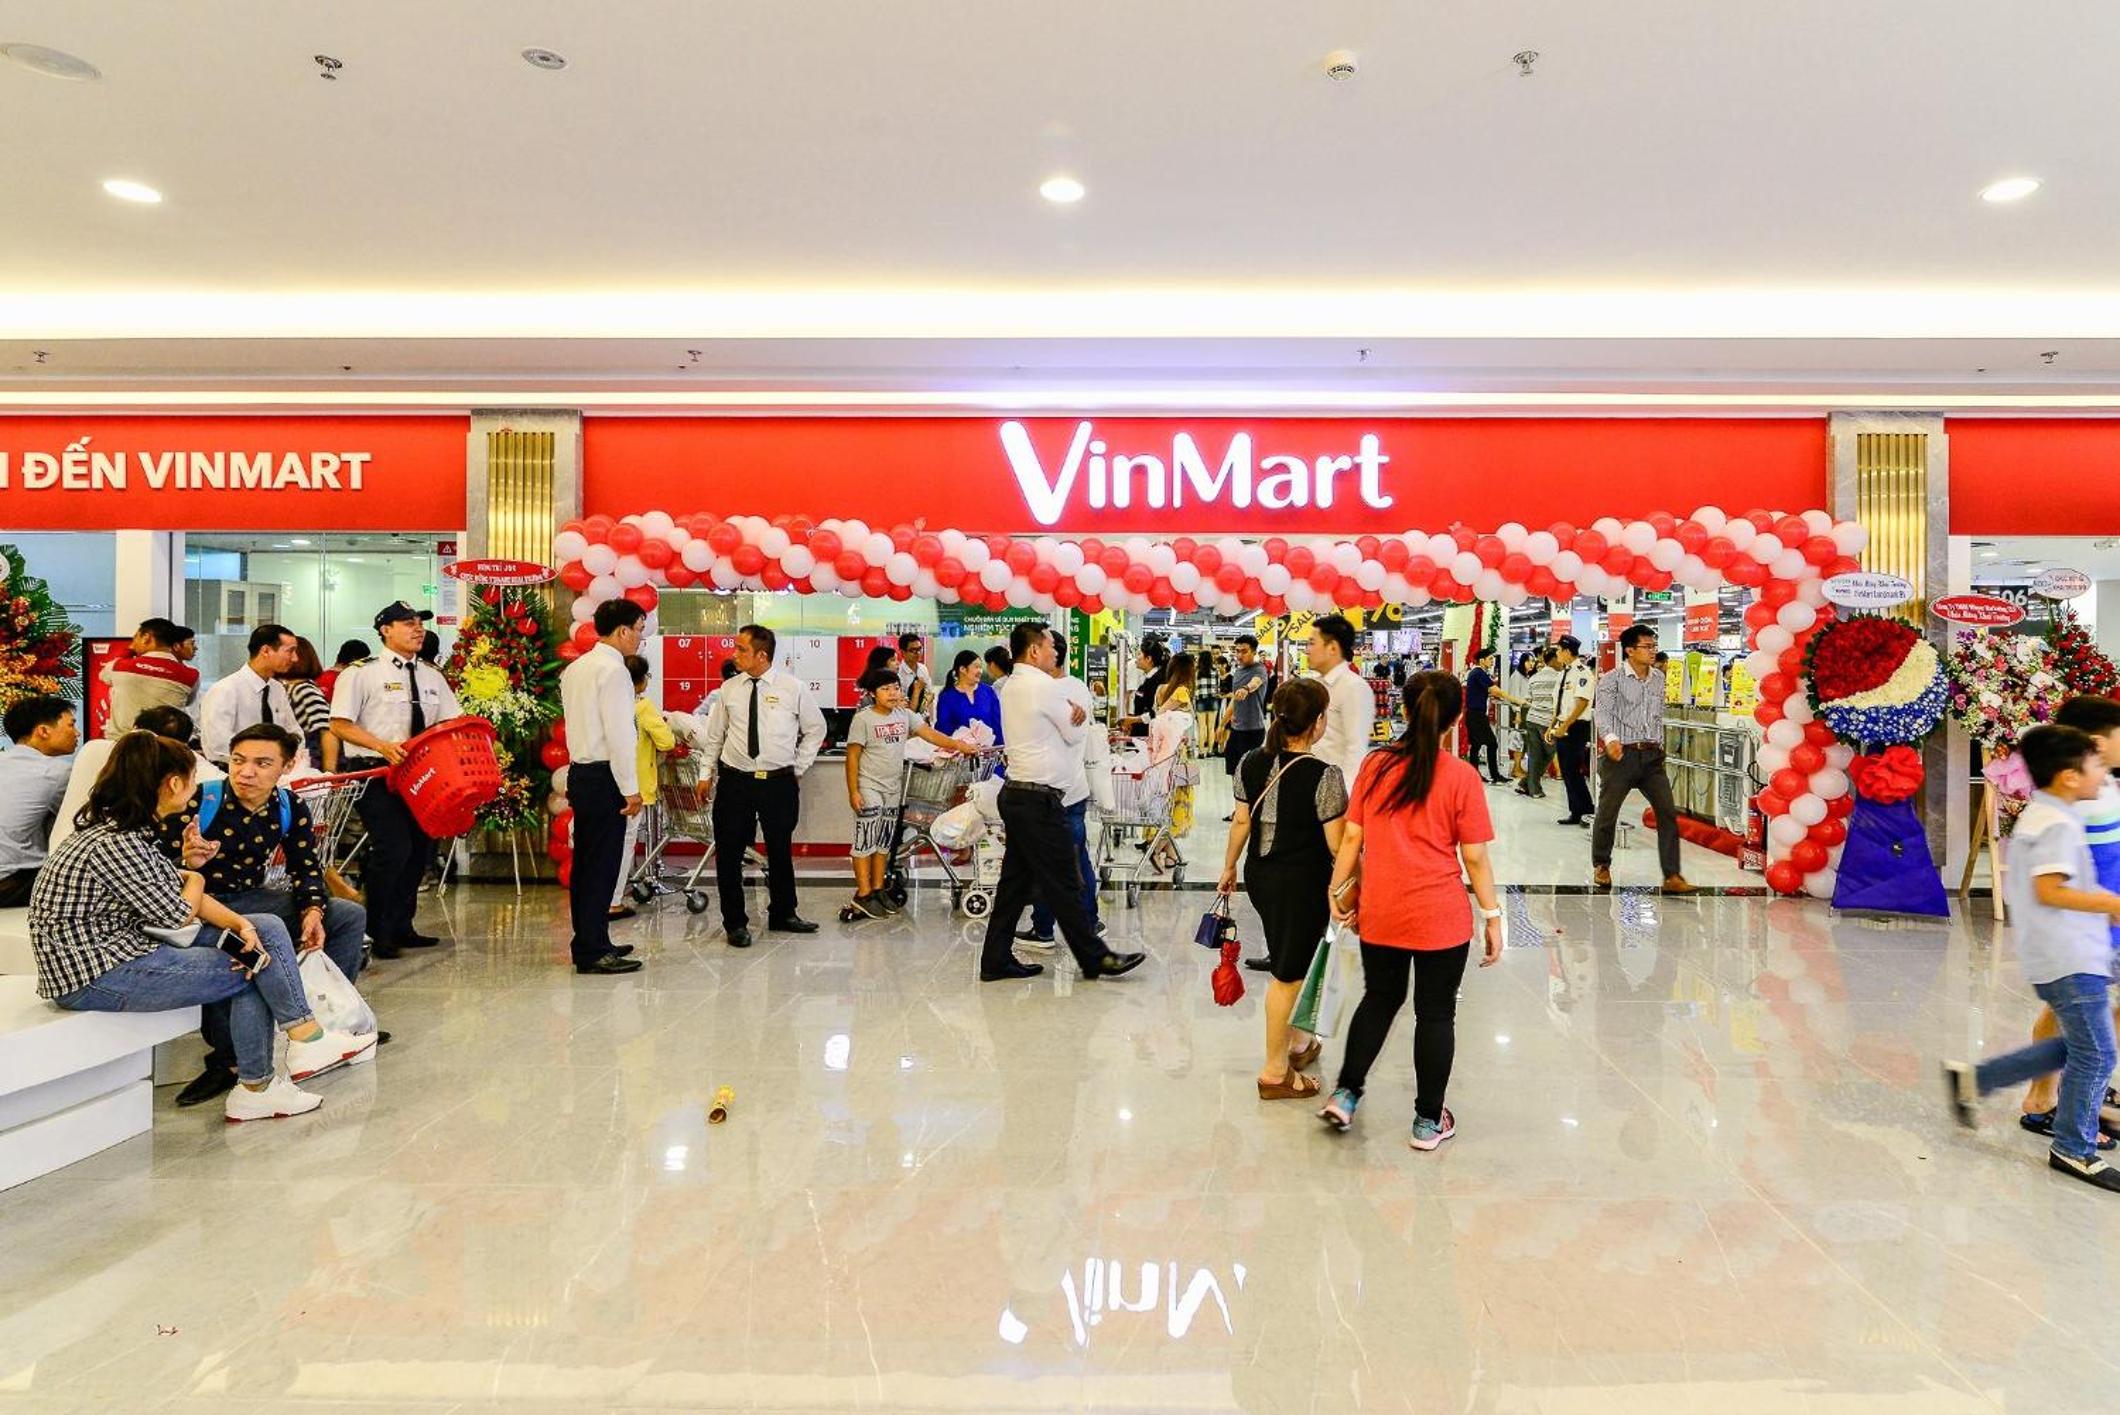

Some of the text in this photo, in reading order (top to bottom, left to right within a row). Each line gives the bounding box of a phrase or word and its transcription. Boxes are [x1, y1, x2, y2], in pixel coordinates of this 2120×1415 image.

[21, 436, 127, 490] ĐẾN
[138, 451, 372, 490] VINMART
[999, 420, 1393, 526] VinMart
[678, 638, 691, 648] 07
[721, 638, 735, 648] 08
[809, 639, 820, 648] 10
[855, 638, 864, 648] 11
[680, 681, 690, 691] 19
[809, 682, 820, 691] 22
